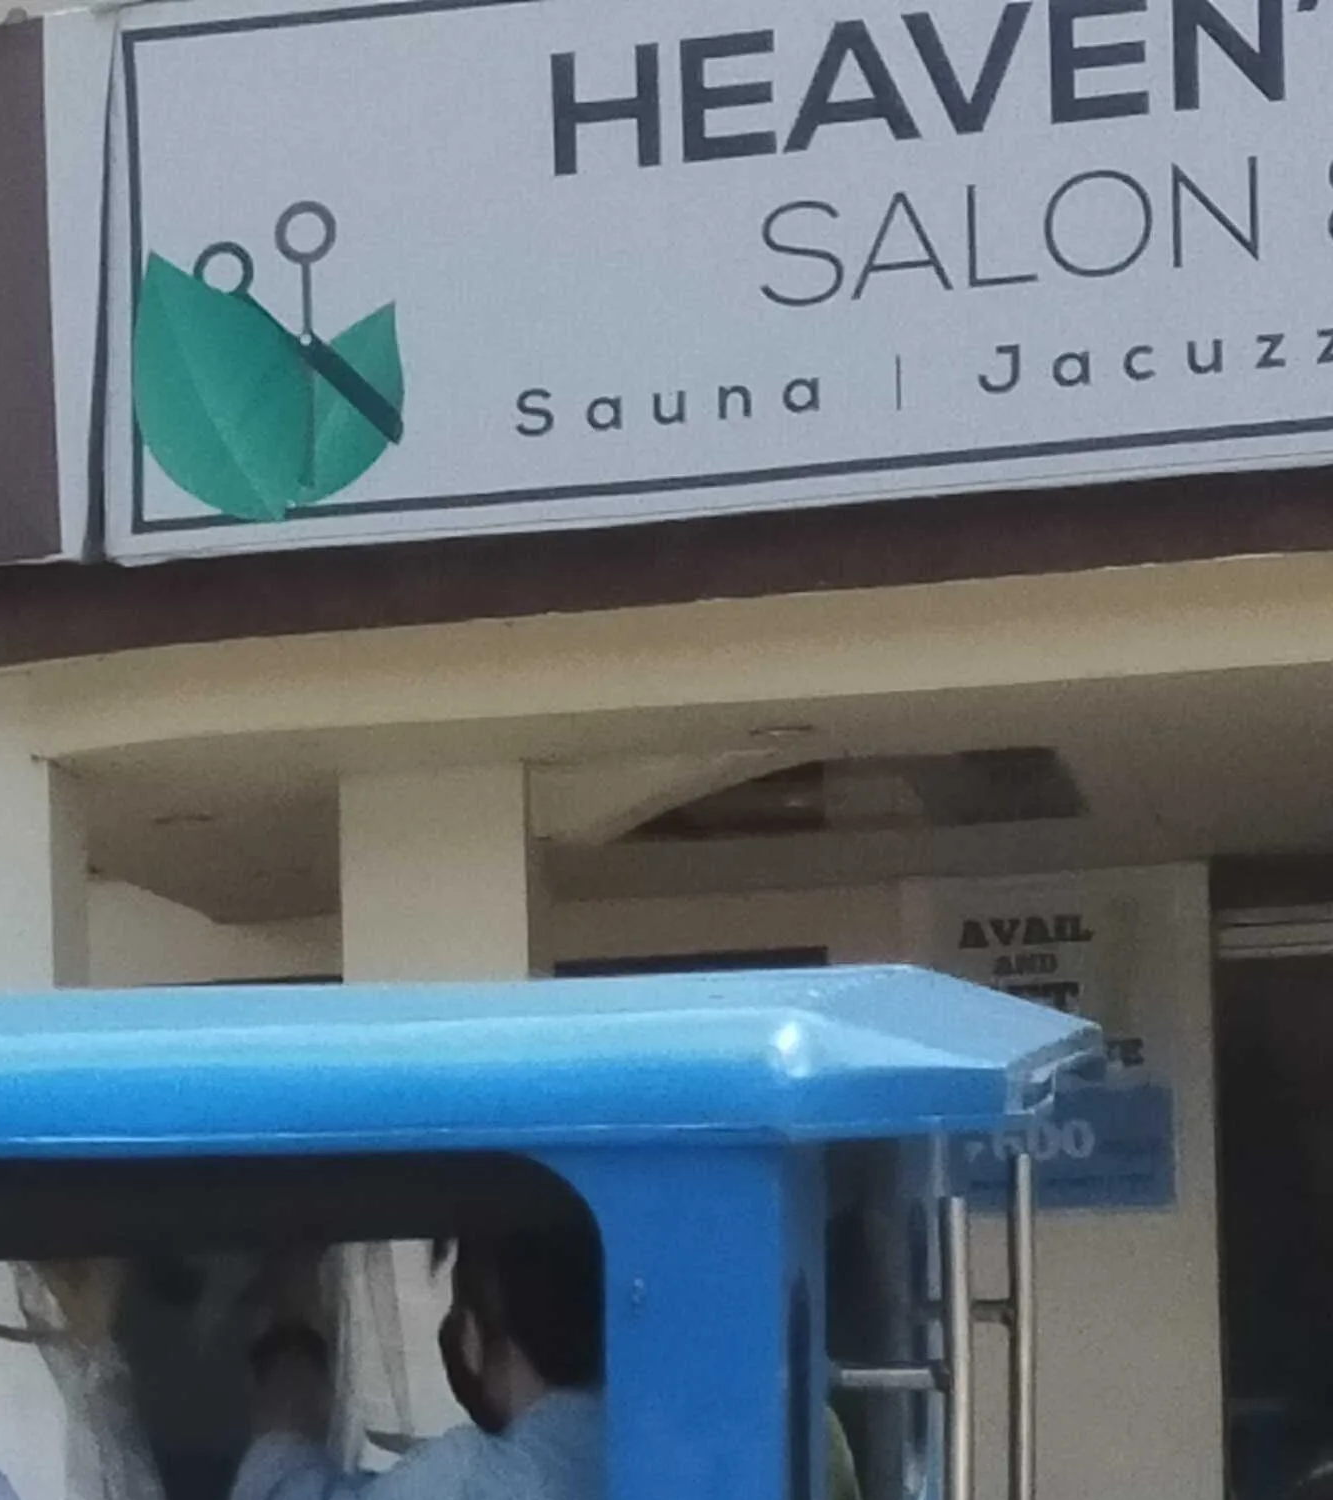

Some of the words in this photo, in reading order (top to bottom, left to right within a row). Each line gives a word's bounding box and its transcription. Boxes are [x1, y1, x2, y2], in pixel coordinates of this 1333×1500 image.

[550, 0, 1319, 176] HEAVEN
[760, 157, 1260, 307] SALON
[516, 370, 820, 437] Sauna
[959, 914, 1093, 950] AVAIL
